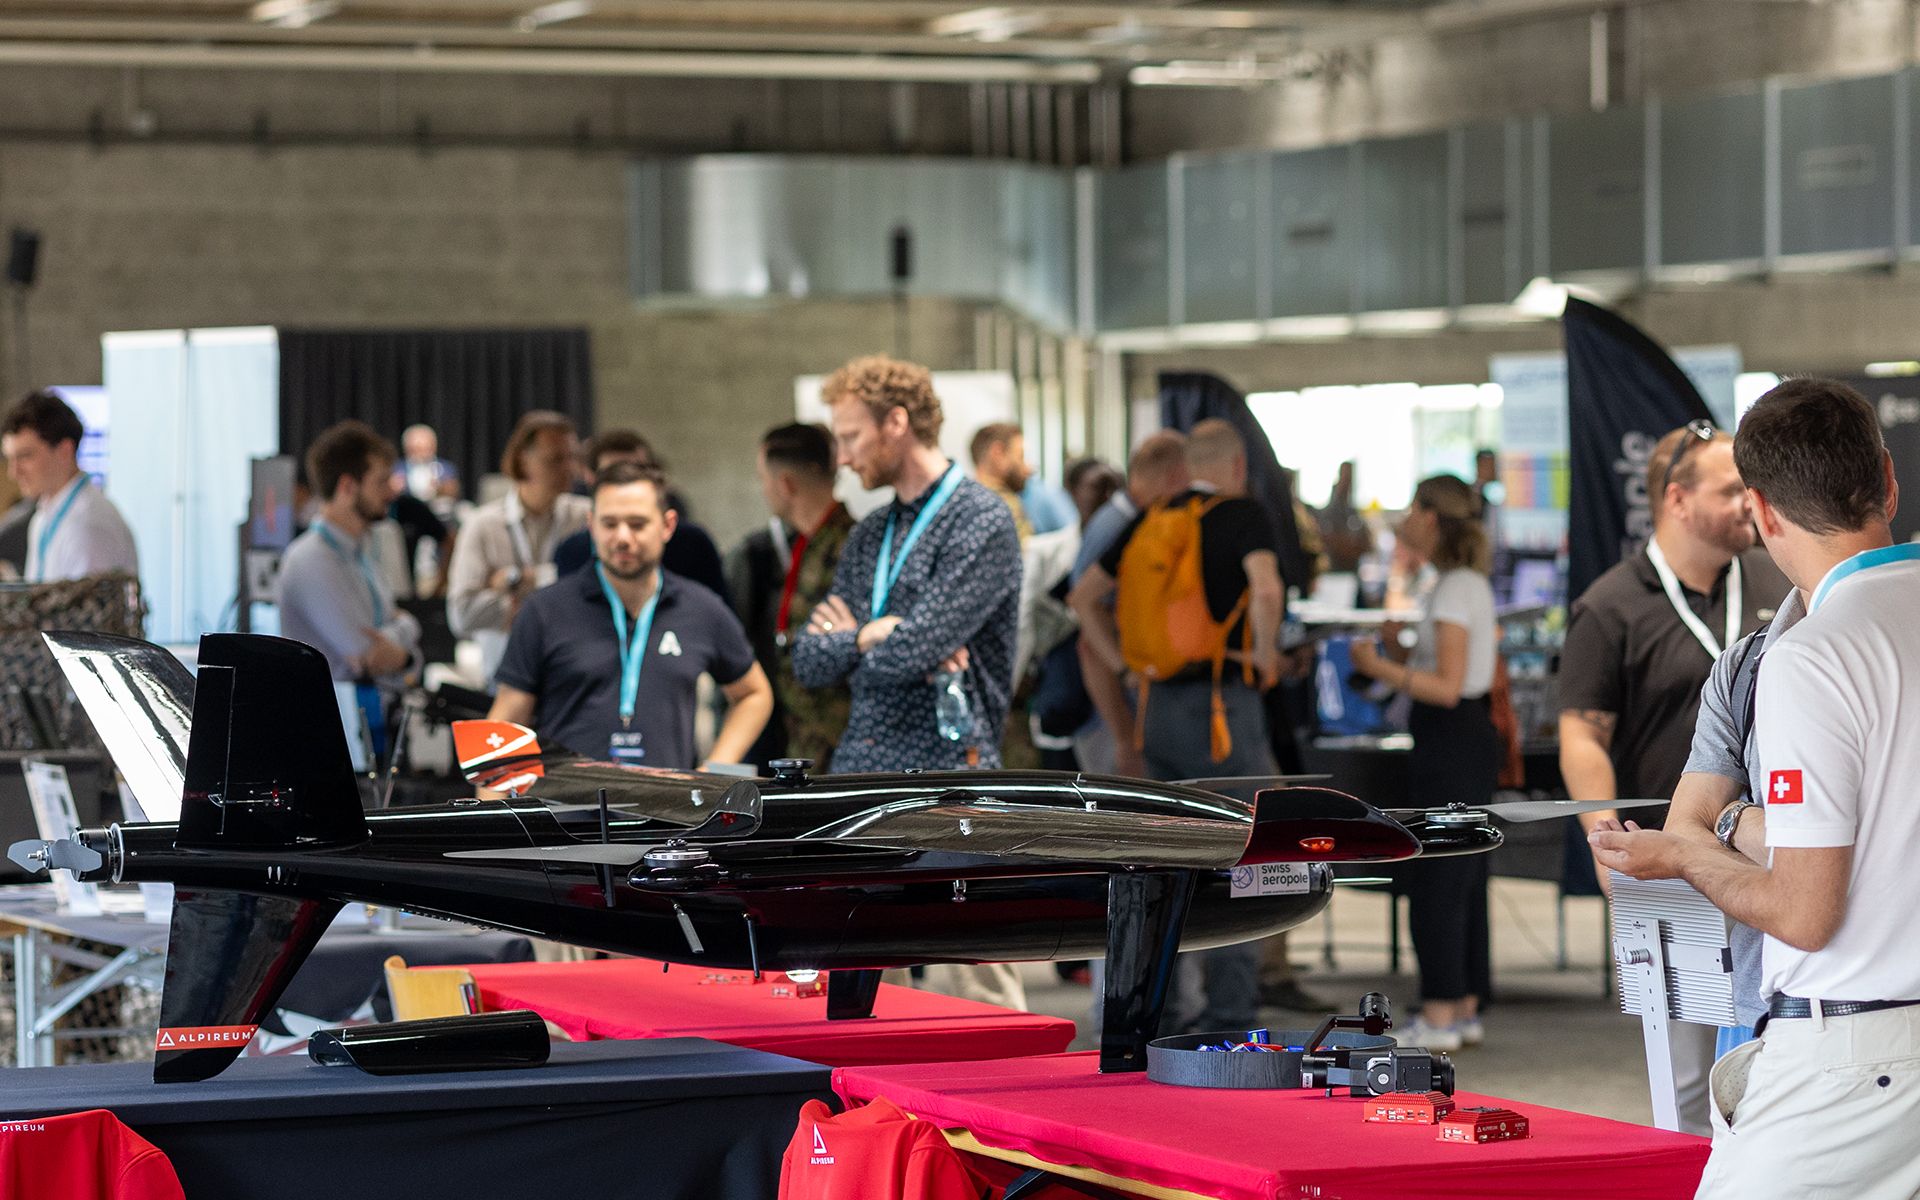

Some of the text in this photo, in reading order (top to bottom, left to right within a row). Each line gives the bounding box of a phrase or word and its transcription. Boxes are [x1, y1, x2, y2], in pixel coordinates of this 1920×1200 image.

[1262, 872, 1308, 887] aeropole
[178, 1031, 251, 1042] ALPIREUM
[0, 1124, 45, 1132] PIREUM
